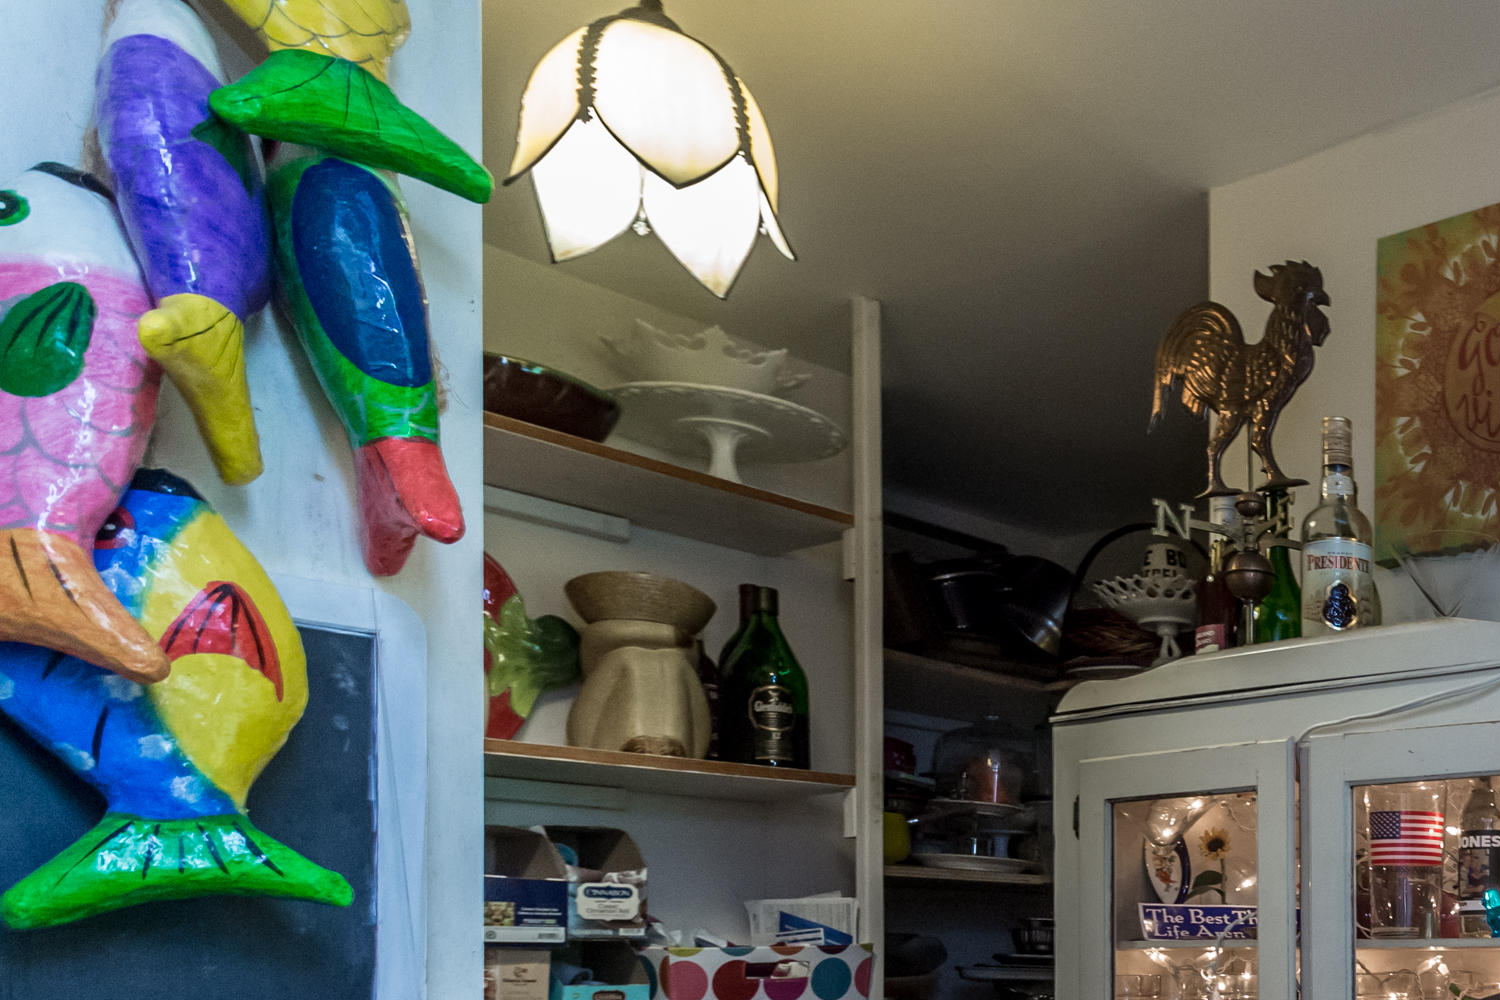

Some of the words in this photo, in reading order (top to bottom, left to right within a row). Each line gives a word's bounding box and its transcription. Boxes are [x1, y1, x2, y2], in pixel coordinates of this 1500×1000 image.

[1145, 908, 1185, 924] The
[1188, 908, 1231, 925] Best
[1153, 925, 1190, 939] Life
